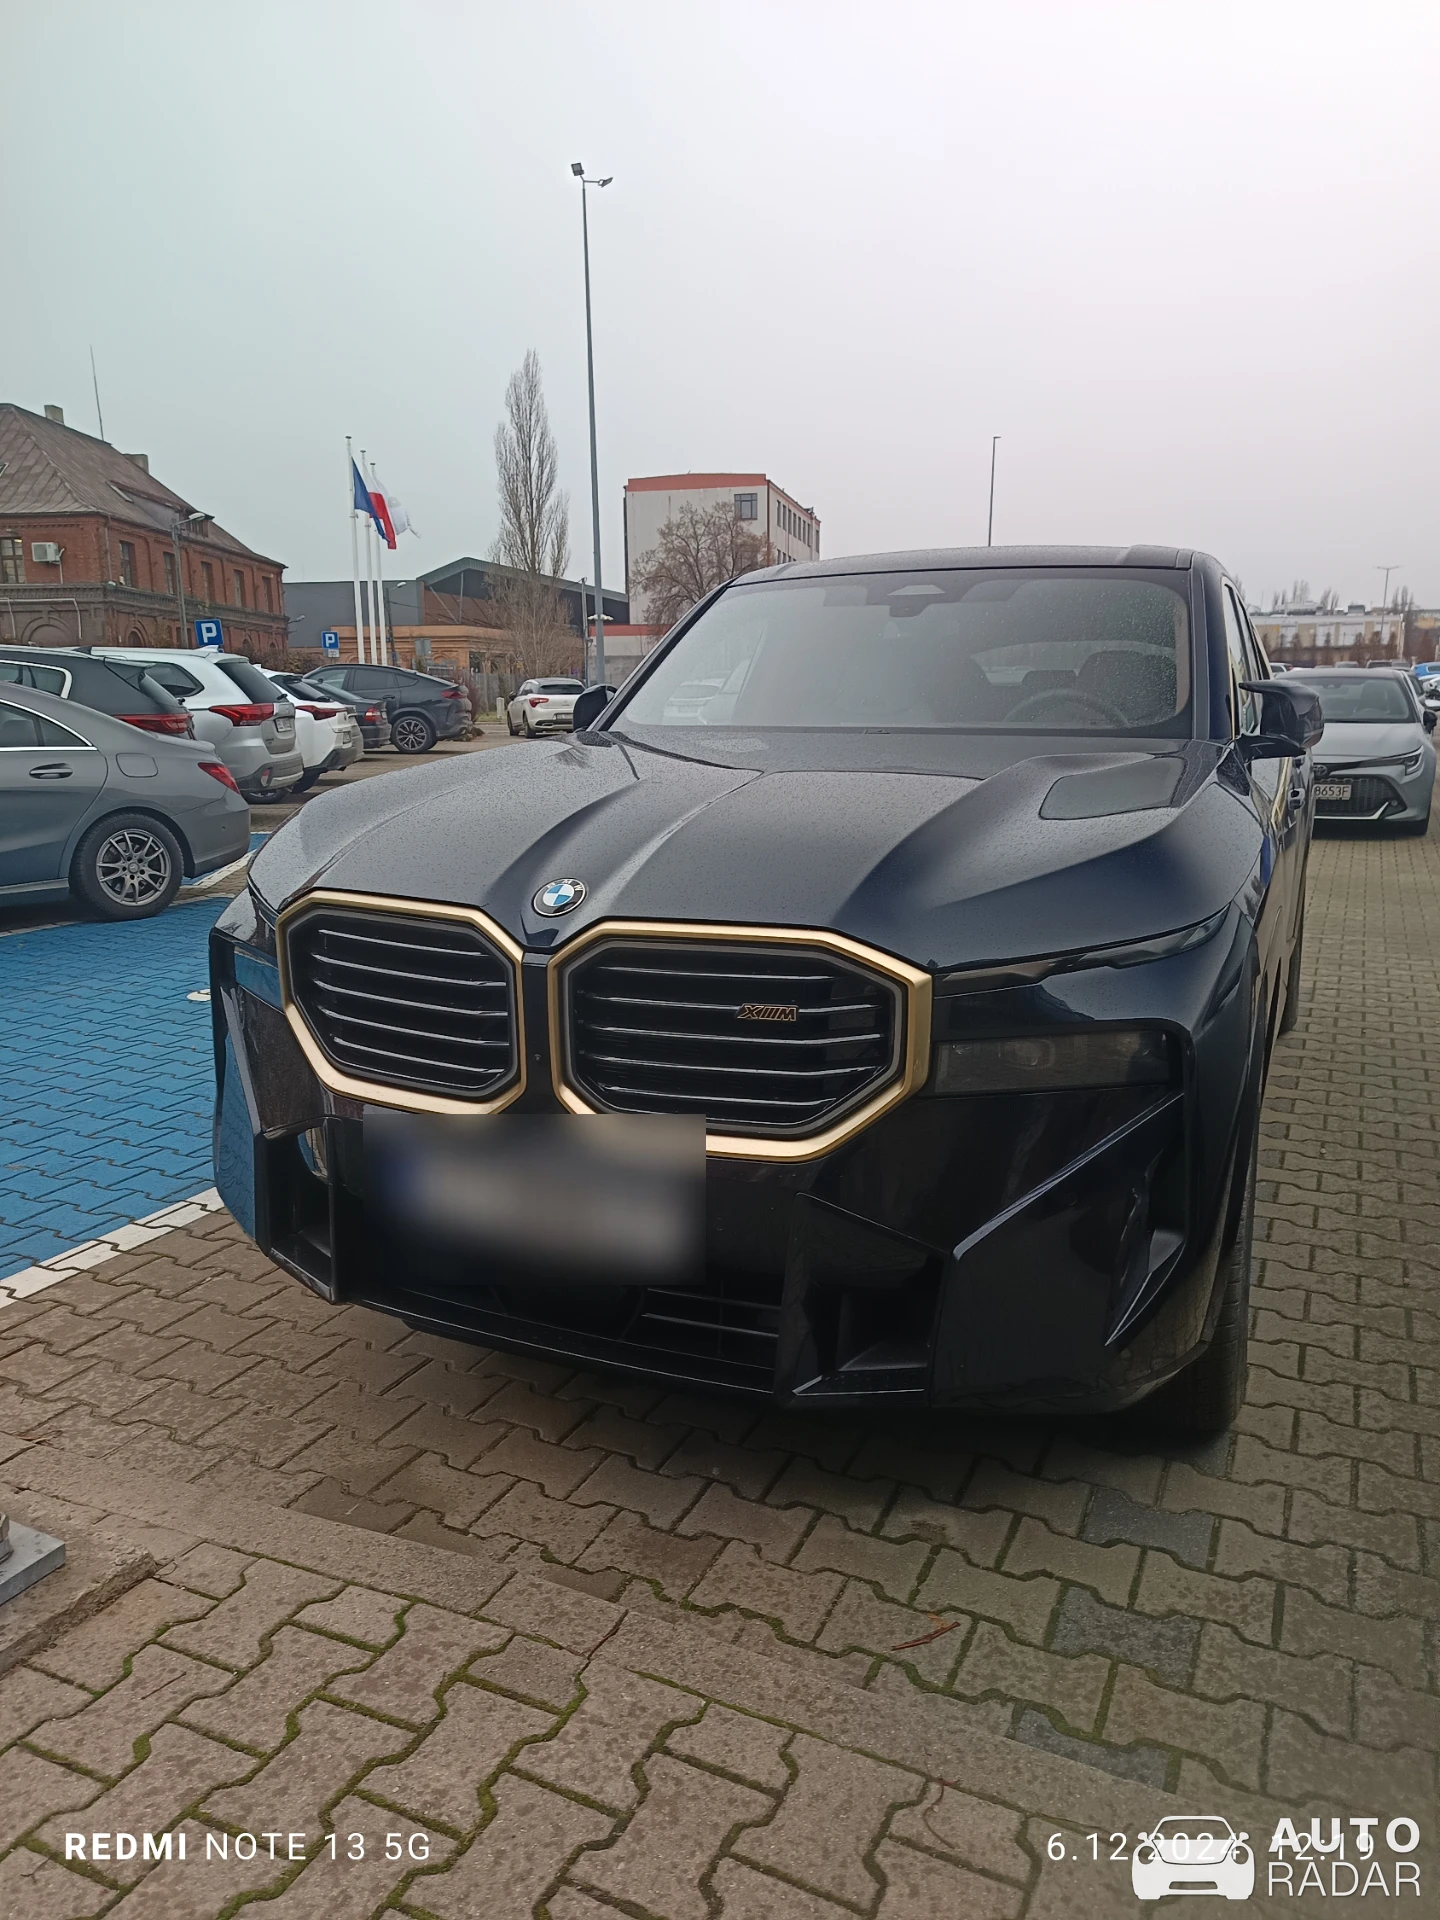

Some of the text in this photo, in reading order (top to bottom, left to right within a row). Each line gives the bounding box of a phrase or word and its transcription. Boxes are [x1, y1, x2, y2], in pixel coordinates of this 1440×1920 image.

[201, 622, 217, 643] P
[325, 633, 335, 647] P
[1315, 785, 1350, 797] 8653F
